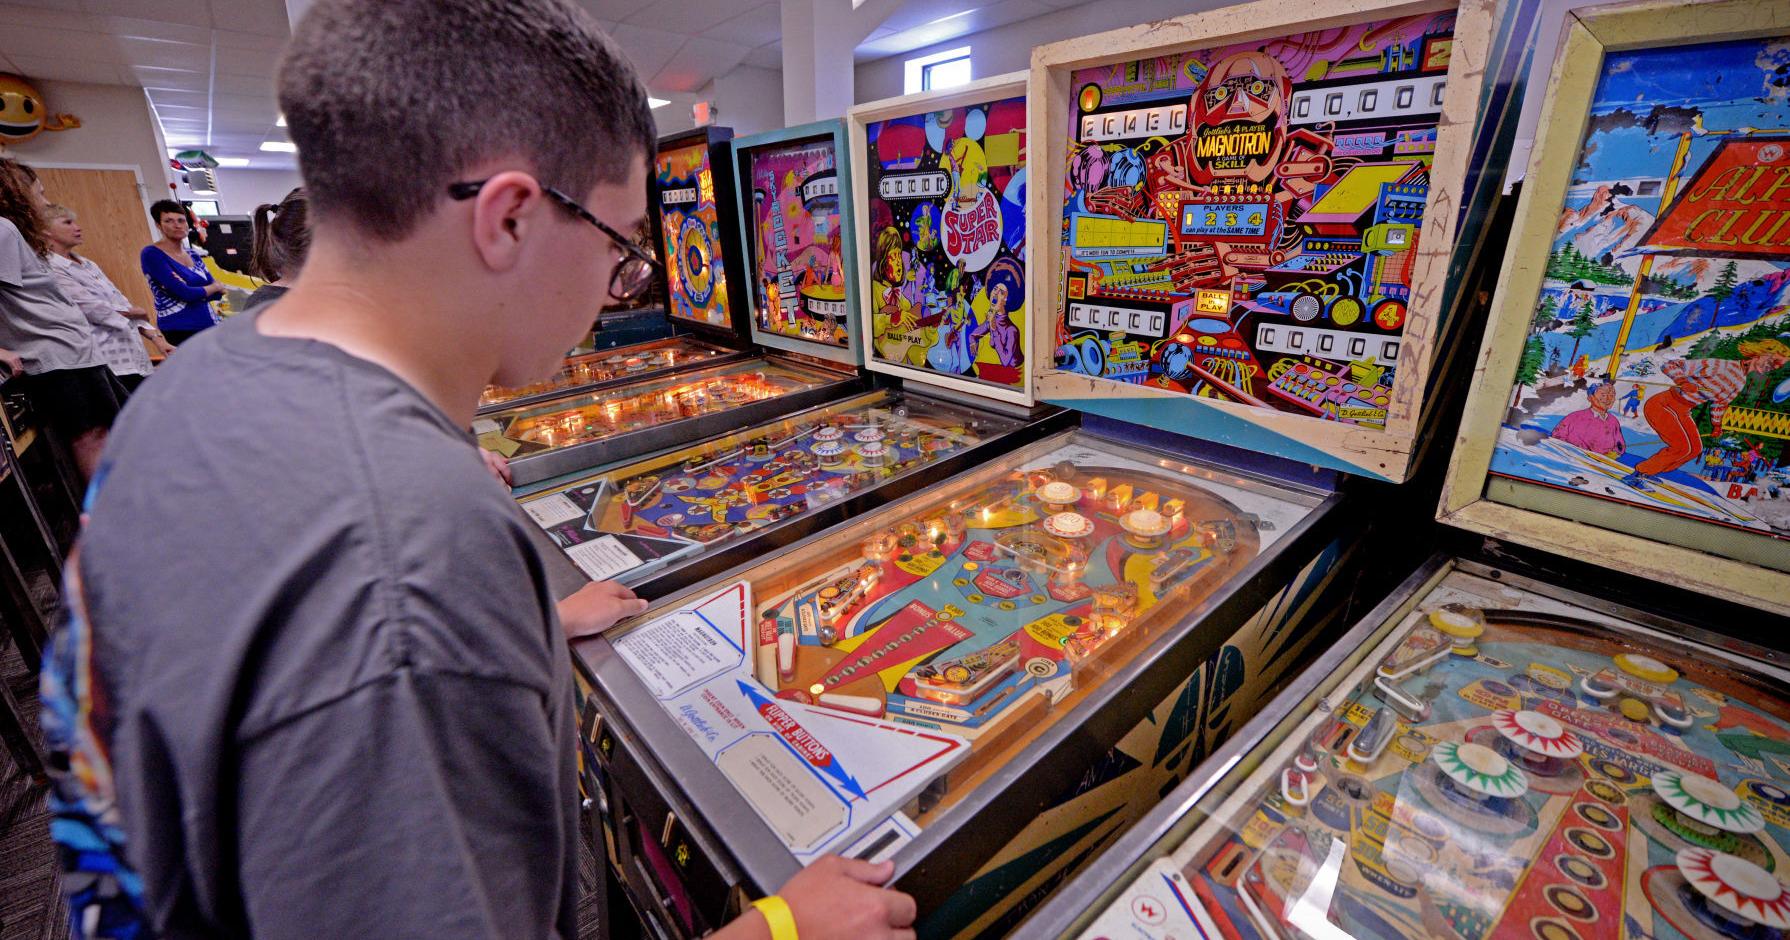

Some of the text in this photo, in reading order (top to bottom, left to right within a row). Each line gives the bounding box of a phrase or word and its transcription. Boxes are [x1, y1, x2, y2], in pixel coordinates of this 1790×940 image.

[1241, 124, 1266, 132] PLAYER
[1196, 131, 1271, 158] MAGNOTRON
[1215, 159, 1247, 169] SKILL
[1203, 204, 1245, 212] PLAYERS
[945, 192, 998, 256] SUPER
[1185, 212, 1264, 226] 1 2 3 4
[1197, 227, 1209, 236] play
[1226, 227, 1244, 235] SAME
[1244, 227, 1260, 235] TIME
[768, 168, 799, 328] SKYROCKET
[1200, 303, 1224, 311] PLAY
[1378, 304, 1400, 326] 4
[907, 335, 922, 344] PLAY
[767, 704, 829, 761] FLIPPER BUTTONS
